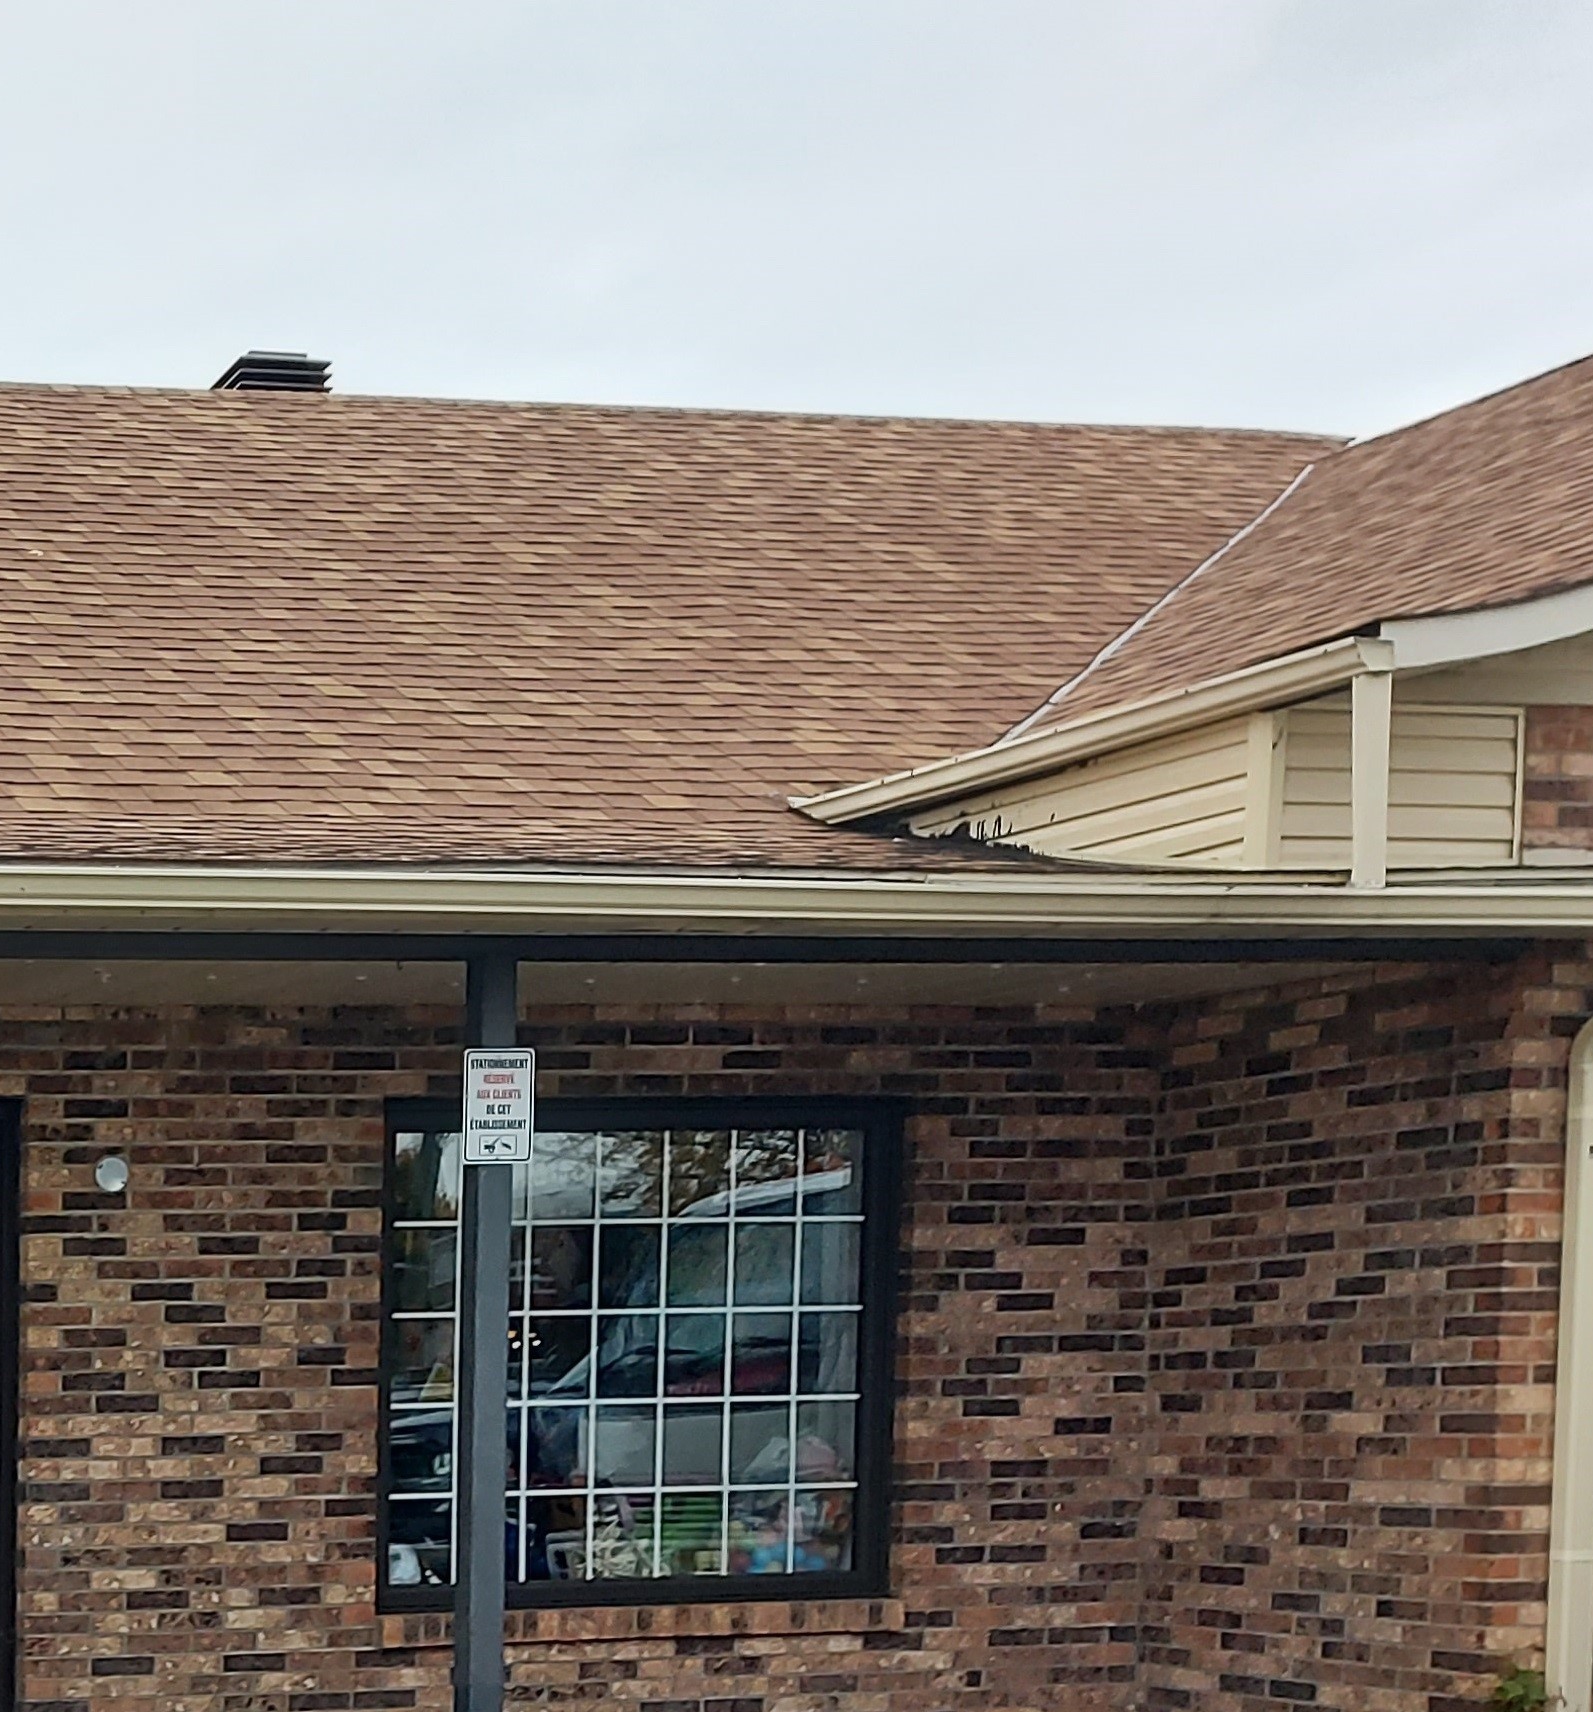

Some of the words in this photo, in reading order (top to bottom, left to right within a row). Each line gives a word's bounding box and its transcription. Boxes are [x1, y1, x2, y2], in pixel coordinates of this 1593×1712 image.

[477, 1090, 490, 1099] AUX
[487, 1104, 495, 1114] DE
[498, 1104, 511, 1114] CET
